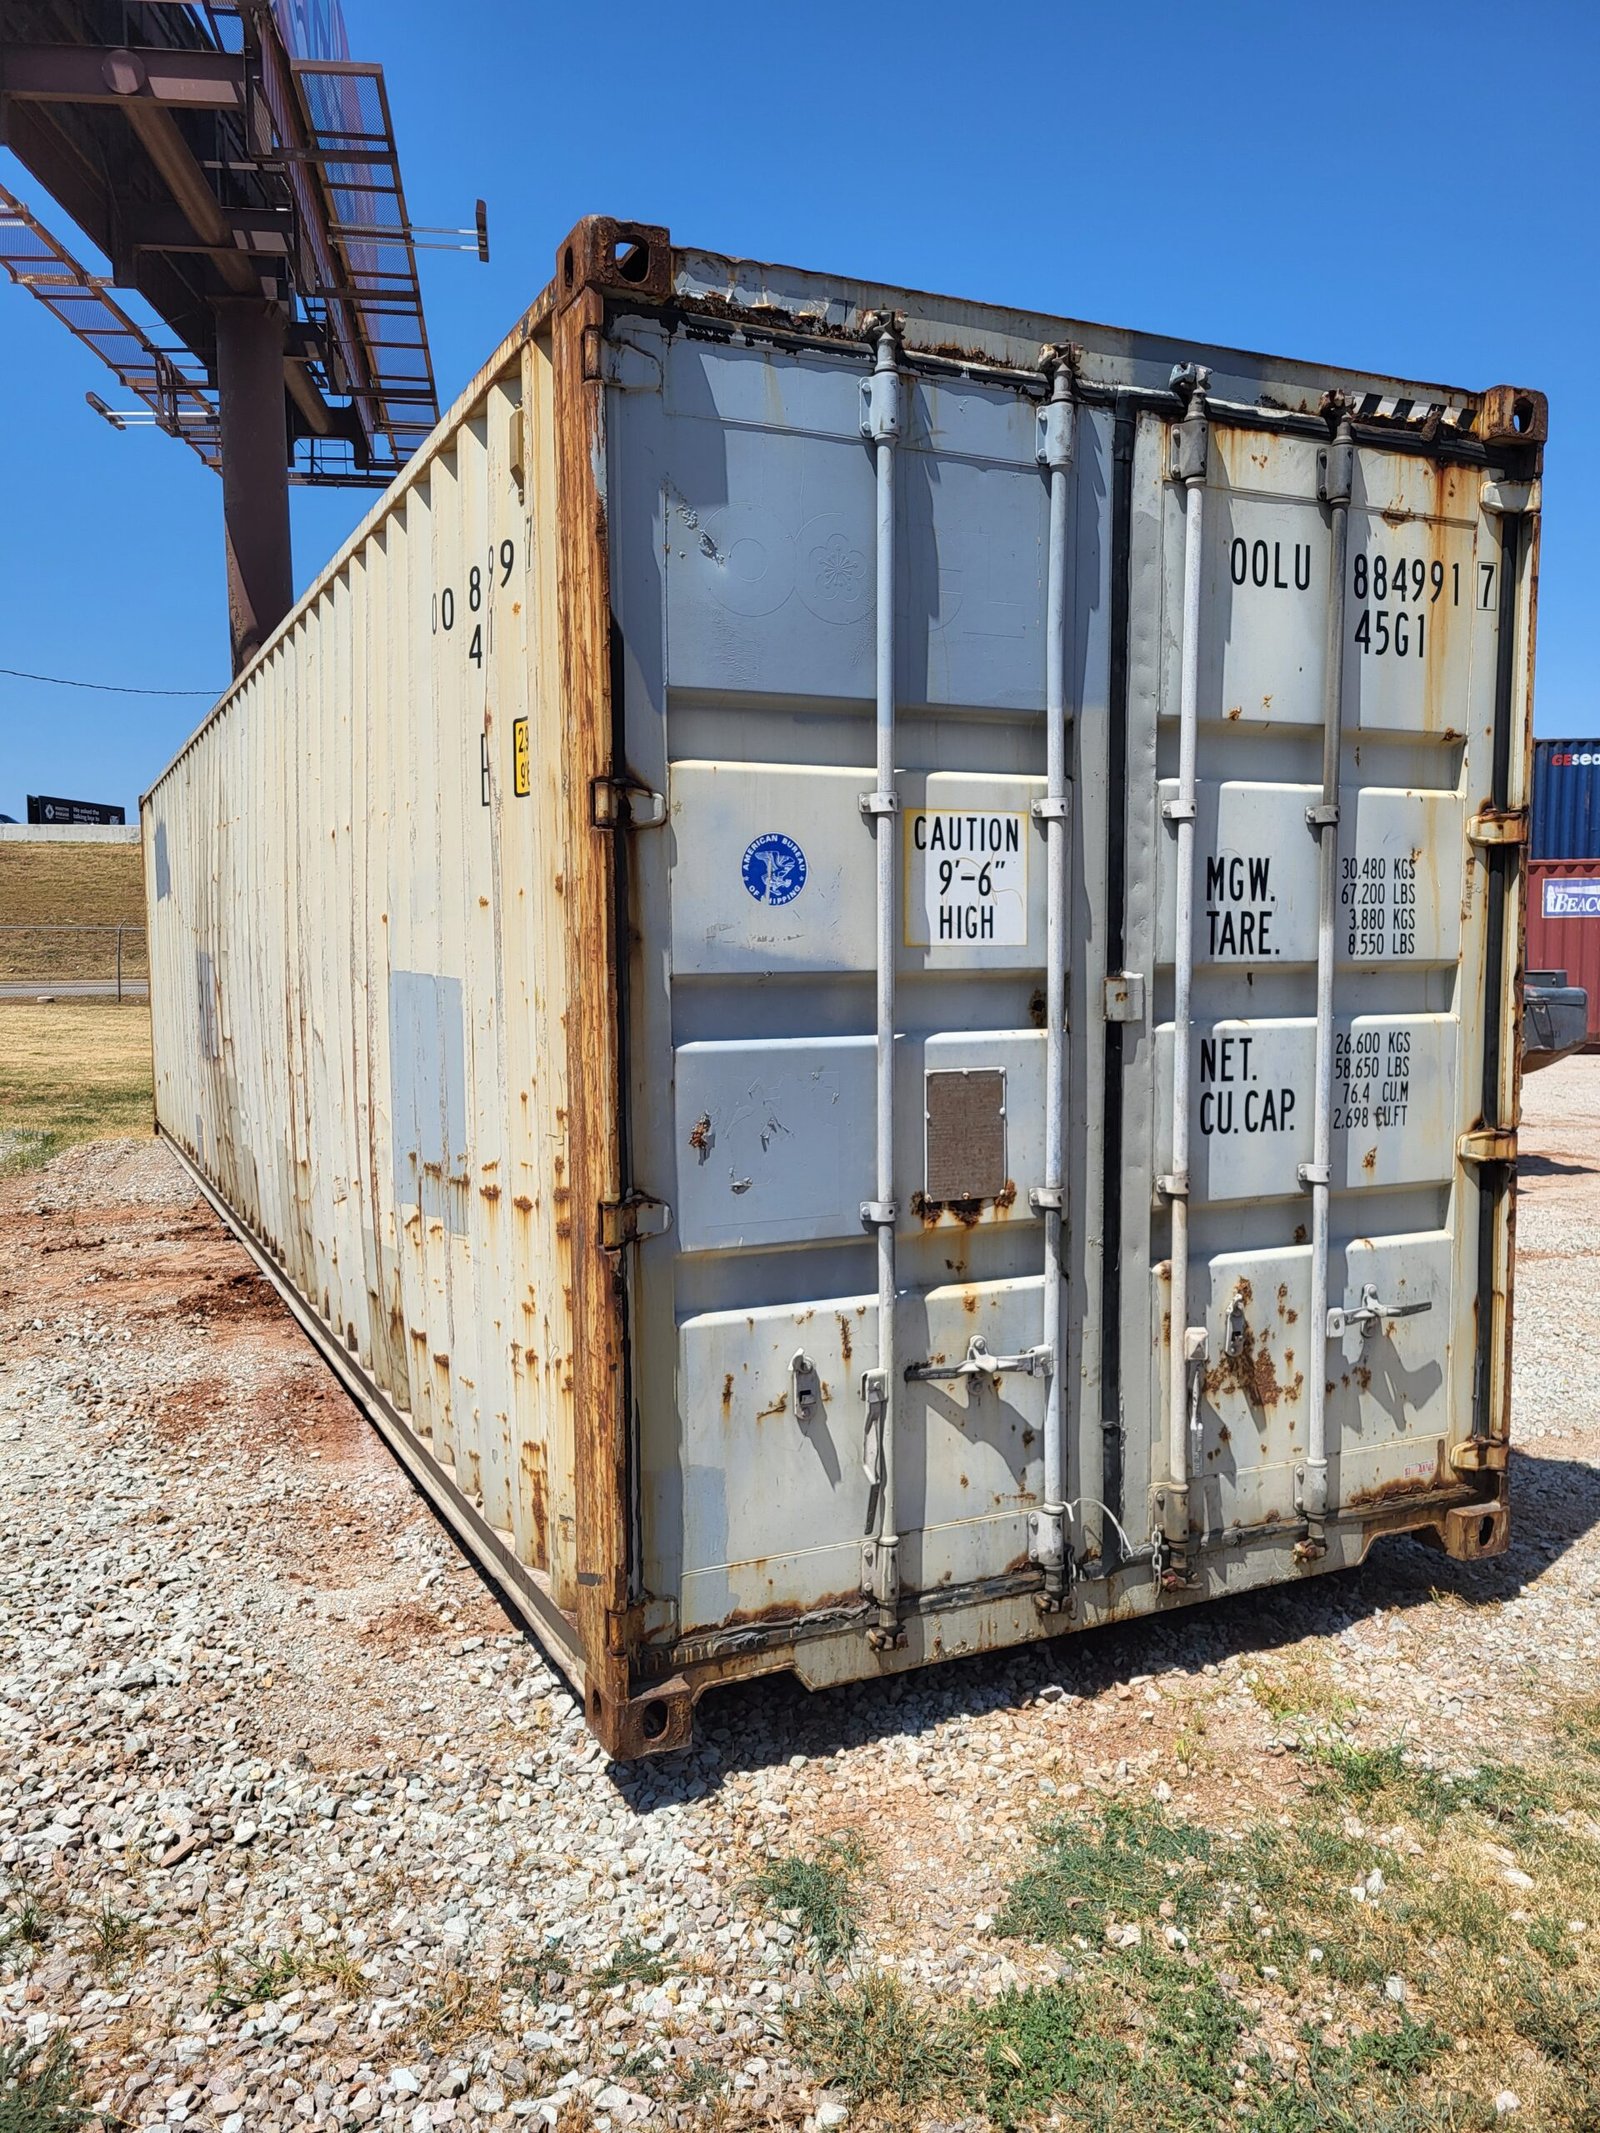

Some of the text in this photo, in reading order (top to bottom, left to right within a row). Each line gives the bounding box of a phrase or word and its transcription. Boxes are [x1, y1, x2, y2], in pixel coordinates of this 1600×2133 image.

[1353, 554, 1460, 606] 884991
[1480, 565, 1495, 607] 7
[1355, 609, 1425, 658] 45G1
[914, 815, 1019, 852] CAUTION
[743, 835, 806, 871] AMERICAN BUREAU
[748, 885, 801, 905] OF HIPPING
[1207, 856, 1416, 902] MGW. 30,480 KGS
[1341, 883, 1416, 905] 67,200 LBS
[1555, 893, 1600, 912] BEAC
[939, 905, 994, 939] HIGH
[1206, 908, 1416, 955] TARE. 3,880 KGS
[1349, 933, 1415, 955] 8,550 LBS
[1200, 1031, 1411, 1082] NET. 26,600 KGS
[1335, 1056, 1410, 1080] 58,650 LBS
[1343, 1082, 1370, 1104] 76.4
[1333, 1106, 1369, 1129] 2,698
